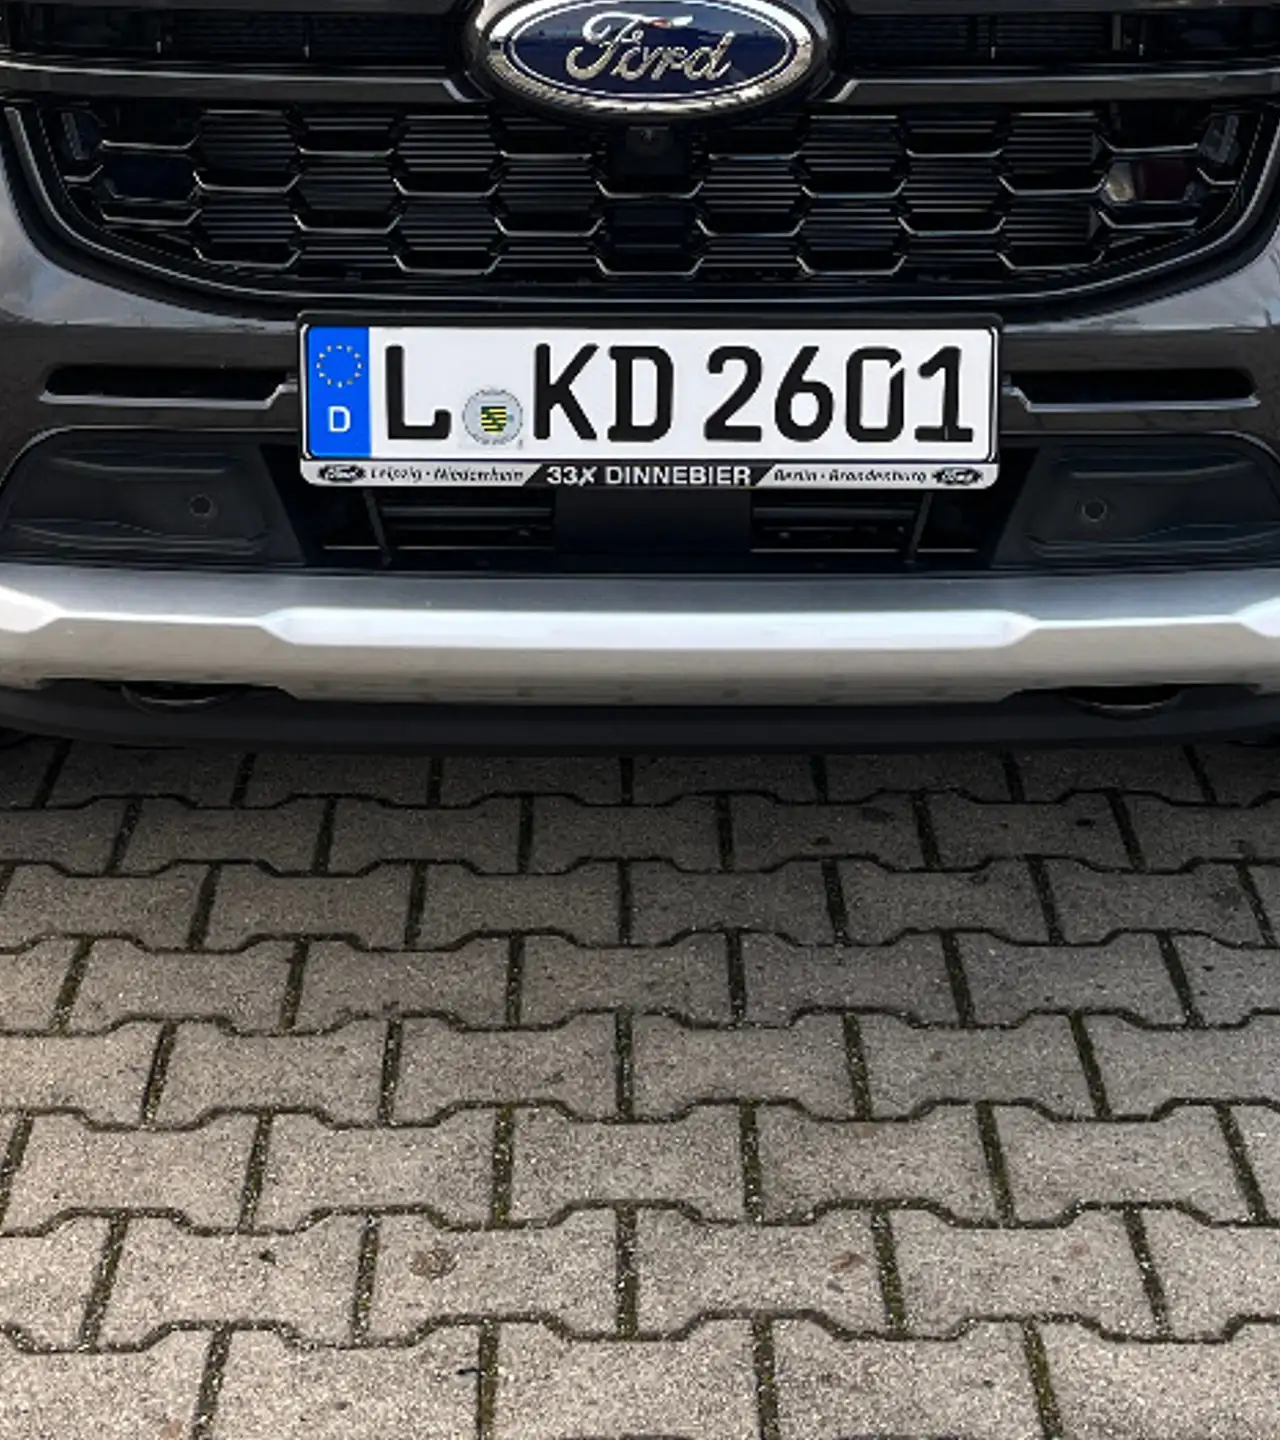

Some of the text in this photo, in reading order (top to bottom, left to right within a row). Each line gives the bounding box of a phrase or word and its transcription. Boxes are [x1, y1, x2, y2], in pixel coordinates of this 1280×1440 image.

[566, 11, 738, 81] Ford
[384, 345, 452, 441] L
[533, 343, 674, 442] KD
[703, 345, 974, 442] 2601
[327, 406, 351, 433] D
[546, 466, 598, 486] 33X
[604, 466, 751, 486] DINNEBIER
[773, 468, 818, 482] Berlin
